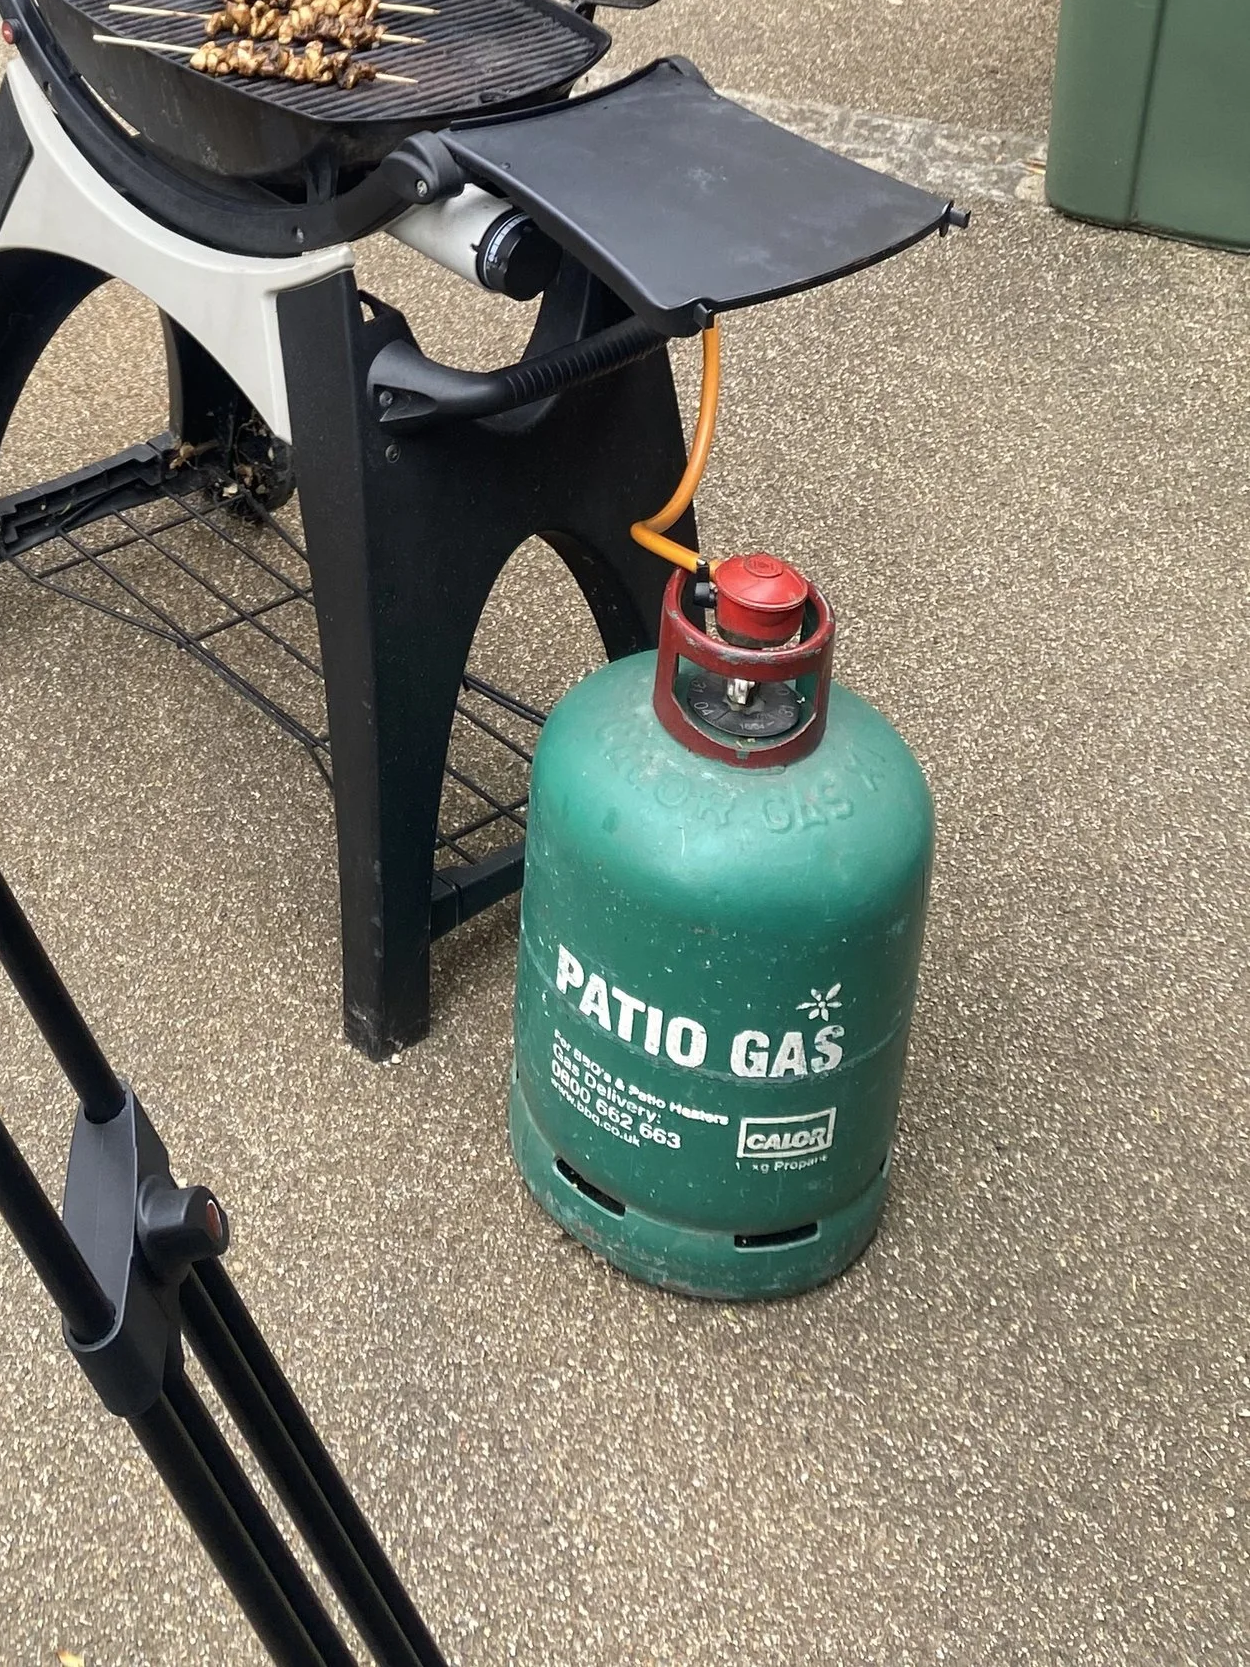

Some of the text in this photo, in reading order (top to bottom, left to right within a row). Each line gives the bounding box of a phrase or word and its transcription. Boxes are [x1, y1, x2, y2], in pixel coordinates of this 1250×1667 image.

[554, 943, 846, 1079] PATIO GAS
[550, 1077, 641, 1148] www.bbq.co.uk
[551, 1059, 682, 1149] 0800 662 663
[552, 1043, 662, 1124] Gas Delivery:
[553, 1028, 572, 1052] For
[614, 1077, 626, 1092] &
[628, 1085, 667, 1109] Patio
[669, 1101, 730, 1126] Heaters
[746, 1126, 827, 1151] CALOR
